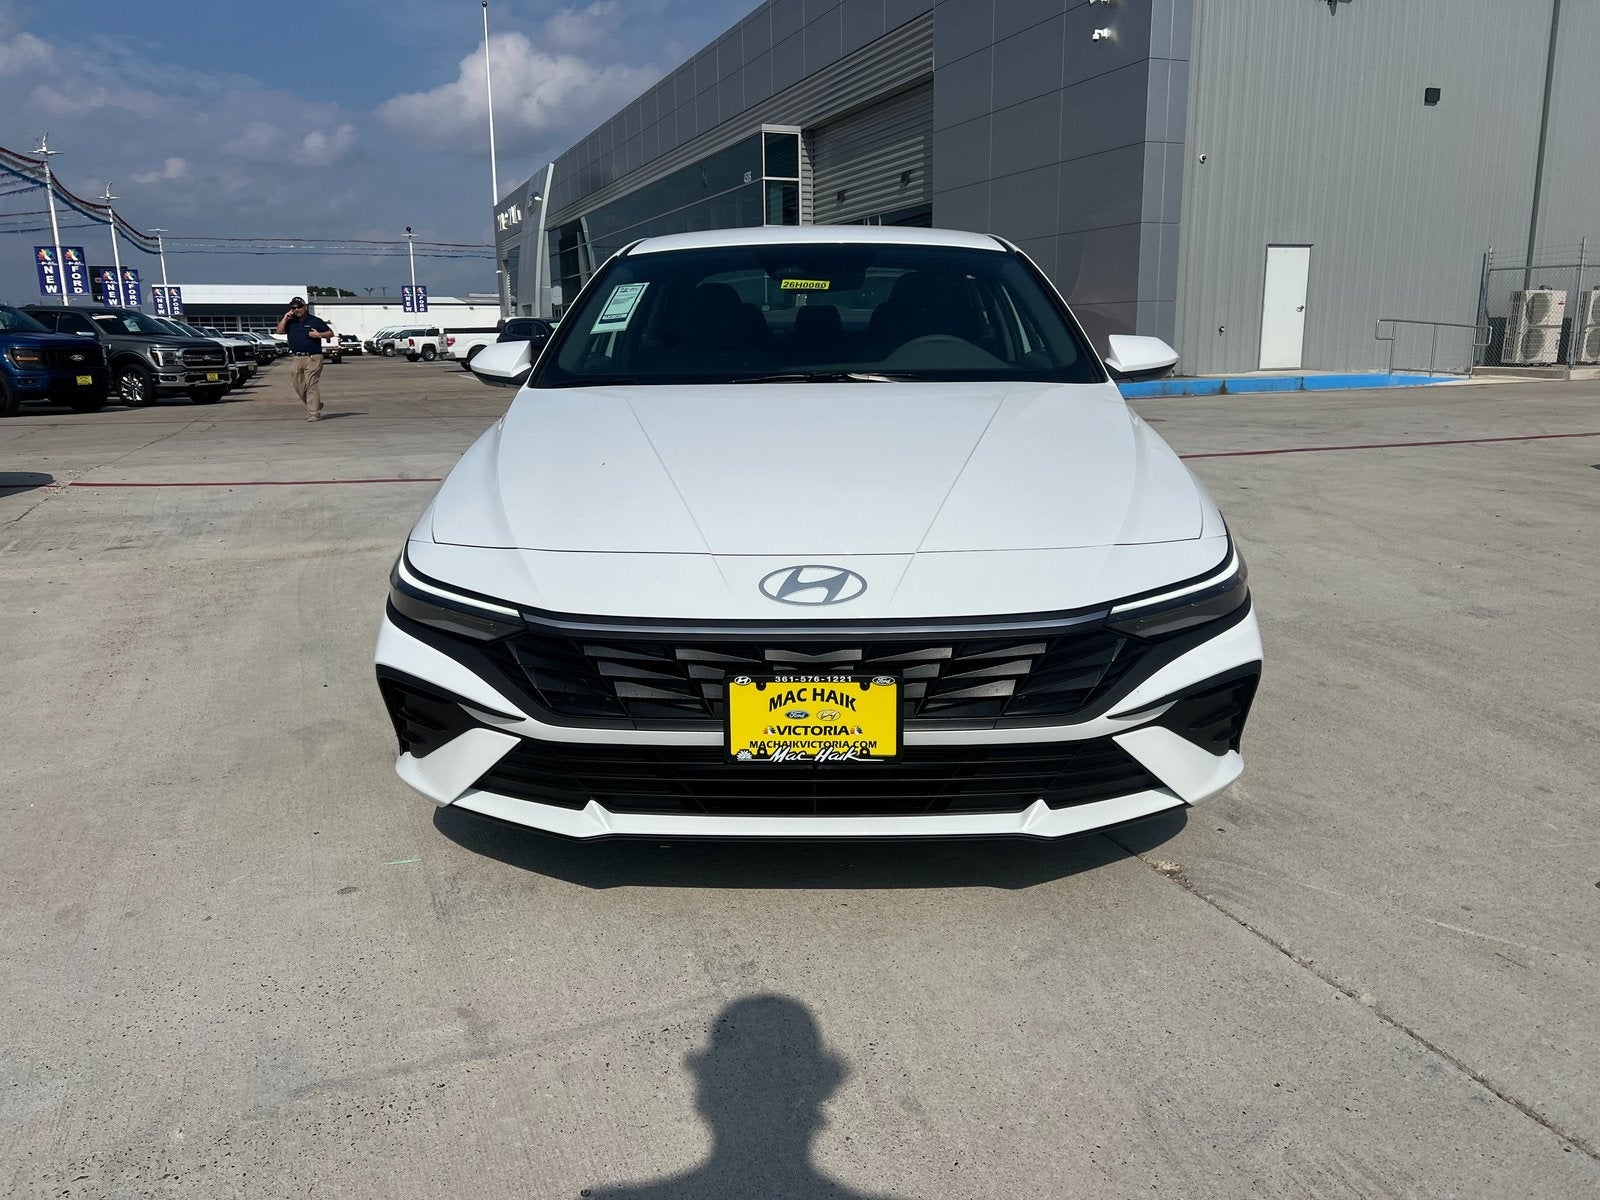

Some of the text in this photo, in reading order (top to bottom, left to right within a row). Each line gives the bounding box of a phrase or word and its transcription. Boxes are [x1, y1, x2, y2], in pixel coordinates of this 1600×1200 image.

[43, 265, 58, 294] NEW
[71, 265, 83, 294] FORD
[783, 281, 827, 289] 26H0080
[107, 284, 118, 306] NEW
[128, 284, 138, 306] FORD
[156, 298, 165, 315] NEW
[172, 298, 180, 315] FORD
[405, 296, 413, 312] NEW
[774, 675, 852, 683] 361-576-1221
[768, 687, 857, 713] MAC HAIK
[788, 710, 806, 719] Ford
[776, 725, 850, 736] VICTORIA
[749, 740, 877, 749] MACHAIKVICTORIACOM
[769, 745, 872, 763] Mac Haik
